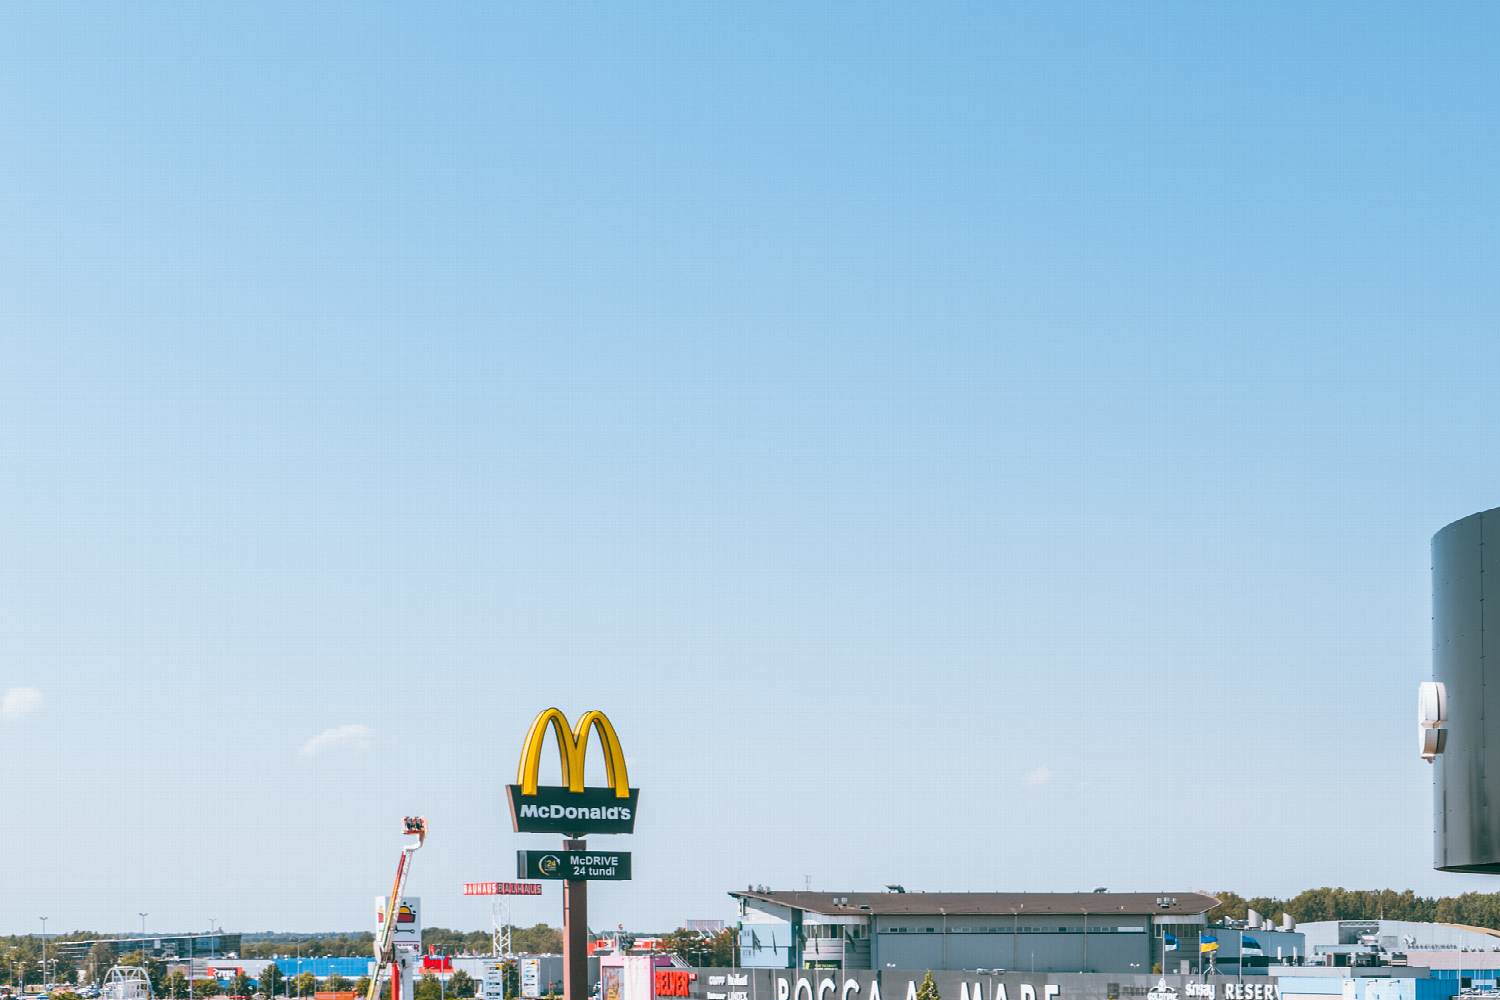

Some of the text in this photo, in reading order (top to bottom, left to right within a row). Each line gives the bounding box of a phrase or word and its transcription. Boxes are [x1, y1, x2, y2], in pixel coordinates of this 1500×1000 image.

[520, 804, 632, 820] McDonald's
[570, 855, 619, 866] McDRIVE
[573, 867, 615, 876] 24 tundi
